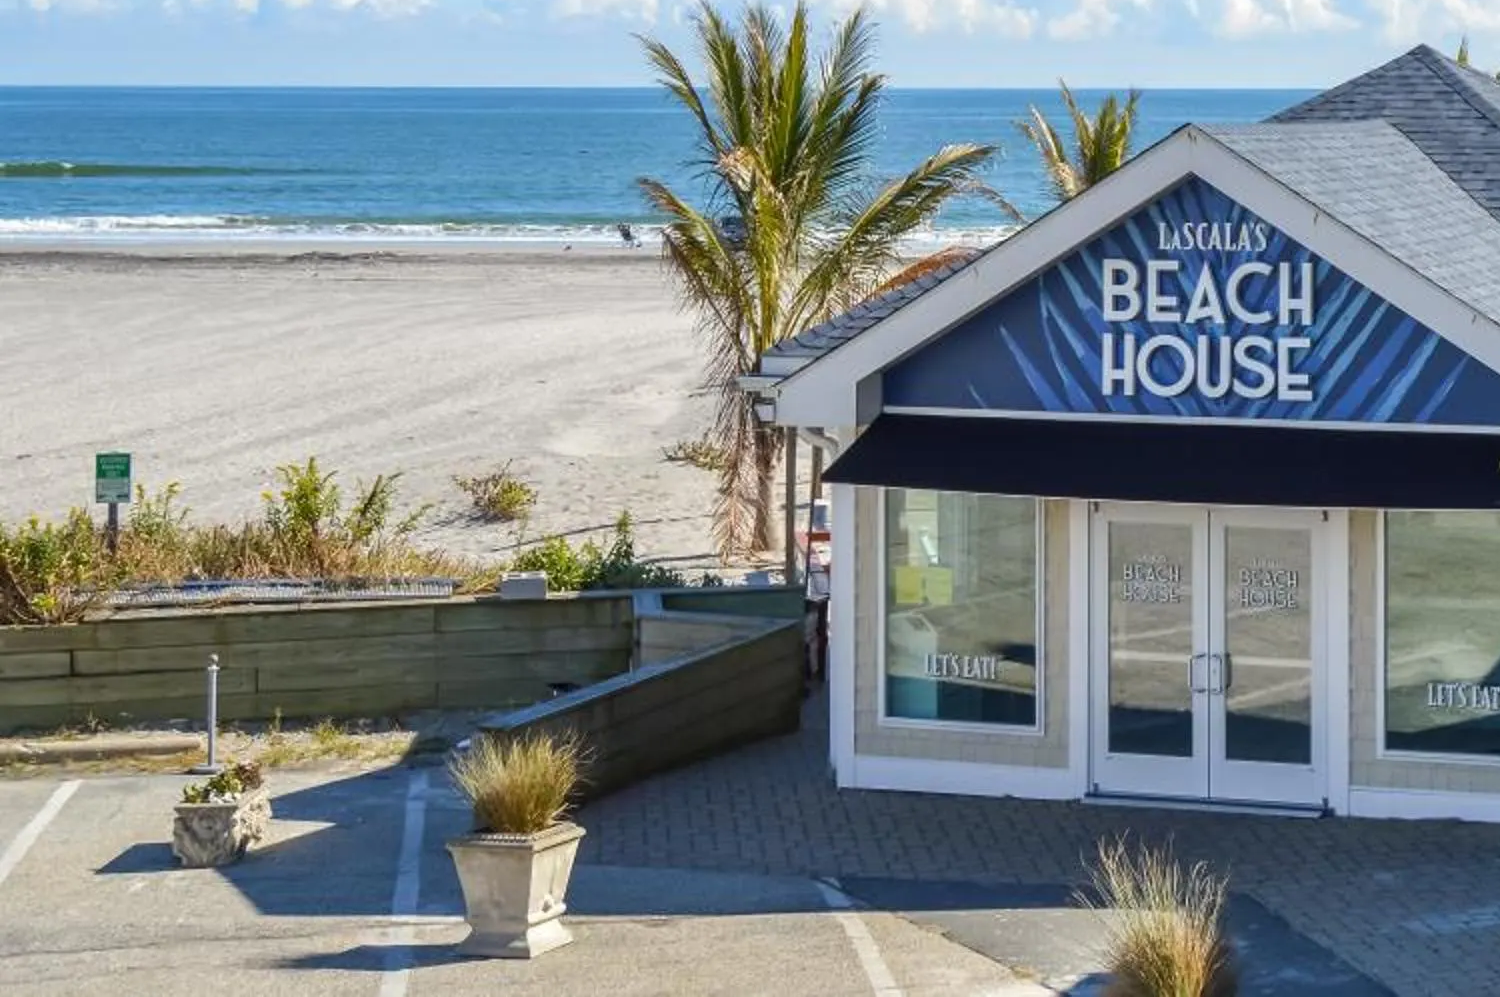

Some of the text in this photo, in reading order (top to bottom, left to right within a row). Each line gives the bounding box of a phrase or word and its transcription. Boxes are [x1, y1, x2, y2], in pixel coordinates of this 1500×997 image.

[1102, 258, 1313, 326] BEACH
[1102, 332, 1313, 402] HOUSE
[1122, 563, 1181, 583] BEACH
[1239, 567, 1299, 588] BEACH
[1427, 682, 1467, 708] LET'S
